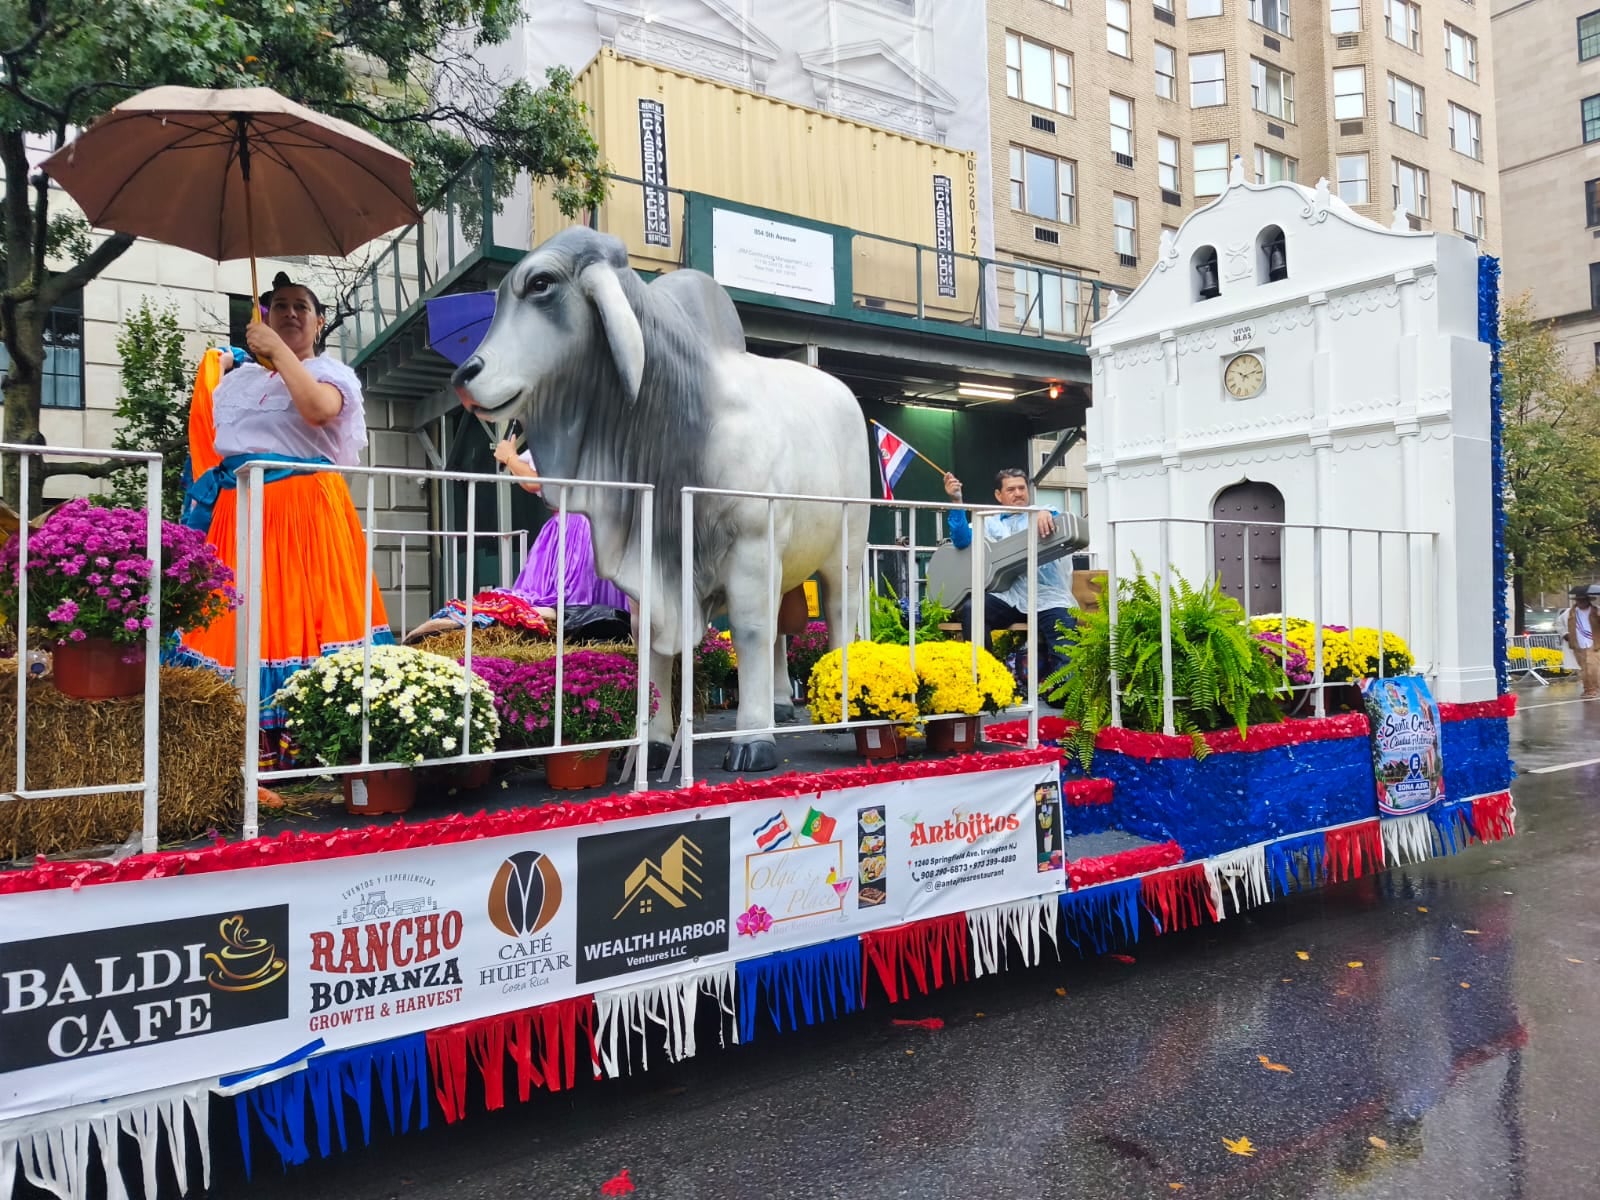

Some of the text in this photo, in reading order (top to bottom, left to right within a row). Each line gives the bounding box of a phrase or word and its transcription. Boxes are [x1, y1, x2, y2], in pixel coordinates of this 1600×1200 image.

[910, 812, 1020, 847] Antojitos
[1008, 842, 1018, 850] NJ
[342, 879, 374, 900] EVENTOS
[385, 873, 436, 887] EXPERIENCIAS
[309, 909, 463, 974] RANCHO
[498, 932, 552, 960] CAFÉ
[584, 918, 726, 961] WEALTH HARBOR
[626, 945, 687, 967] Ventures LLC
[2, 943, 206, 1014] BALDI
[309, 957, 463, 1014] BONANZA
[480, 954, 573, 986] HUETAR
[502, 976, 550, 994] Costa Rica
[48, 993, 211, 1057] CAFE
[309, 987, 463, 1032] GROWTH & HARVEST
